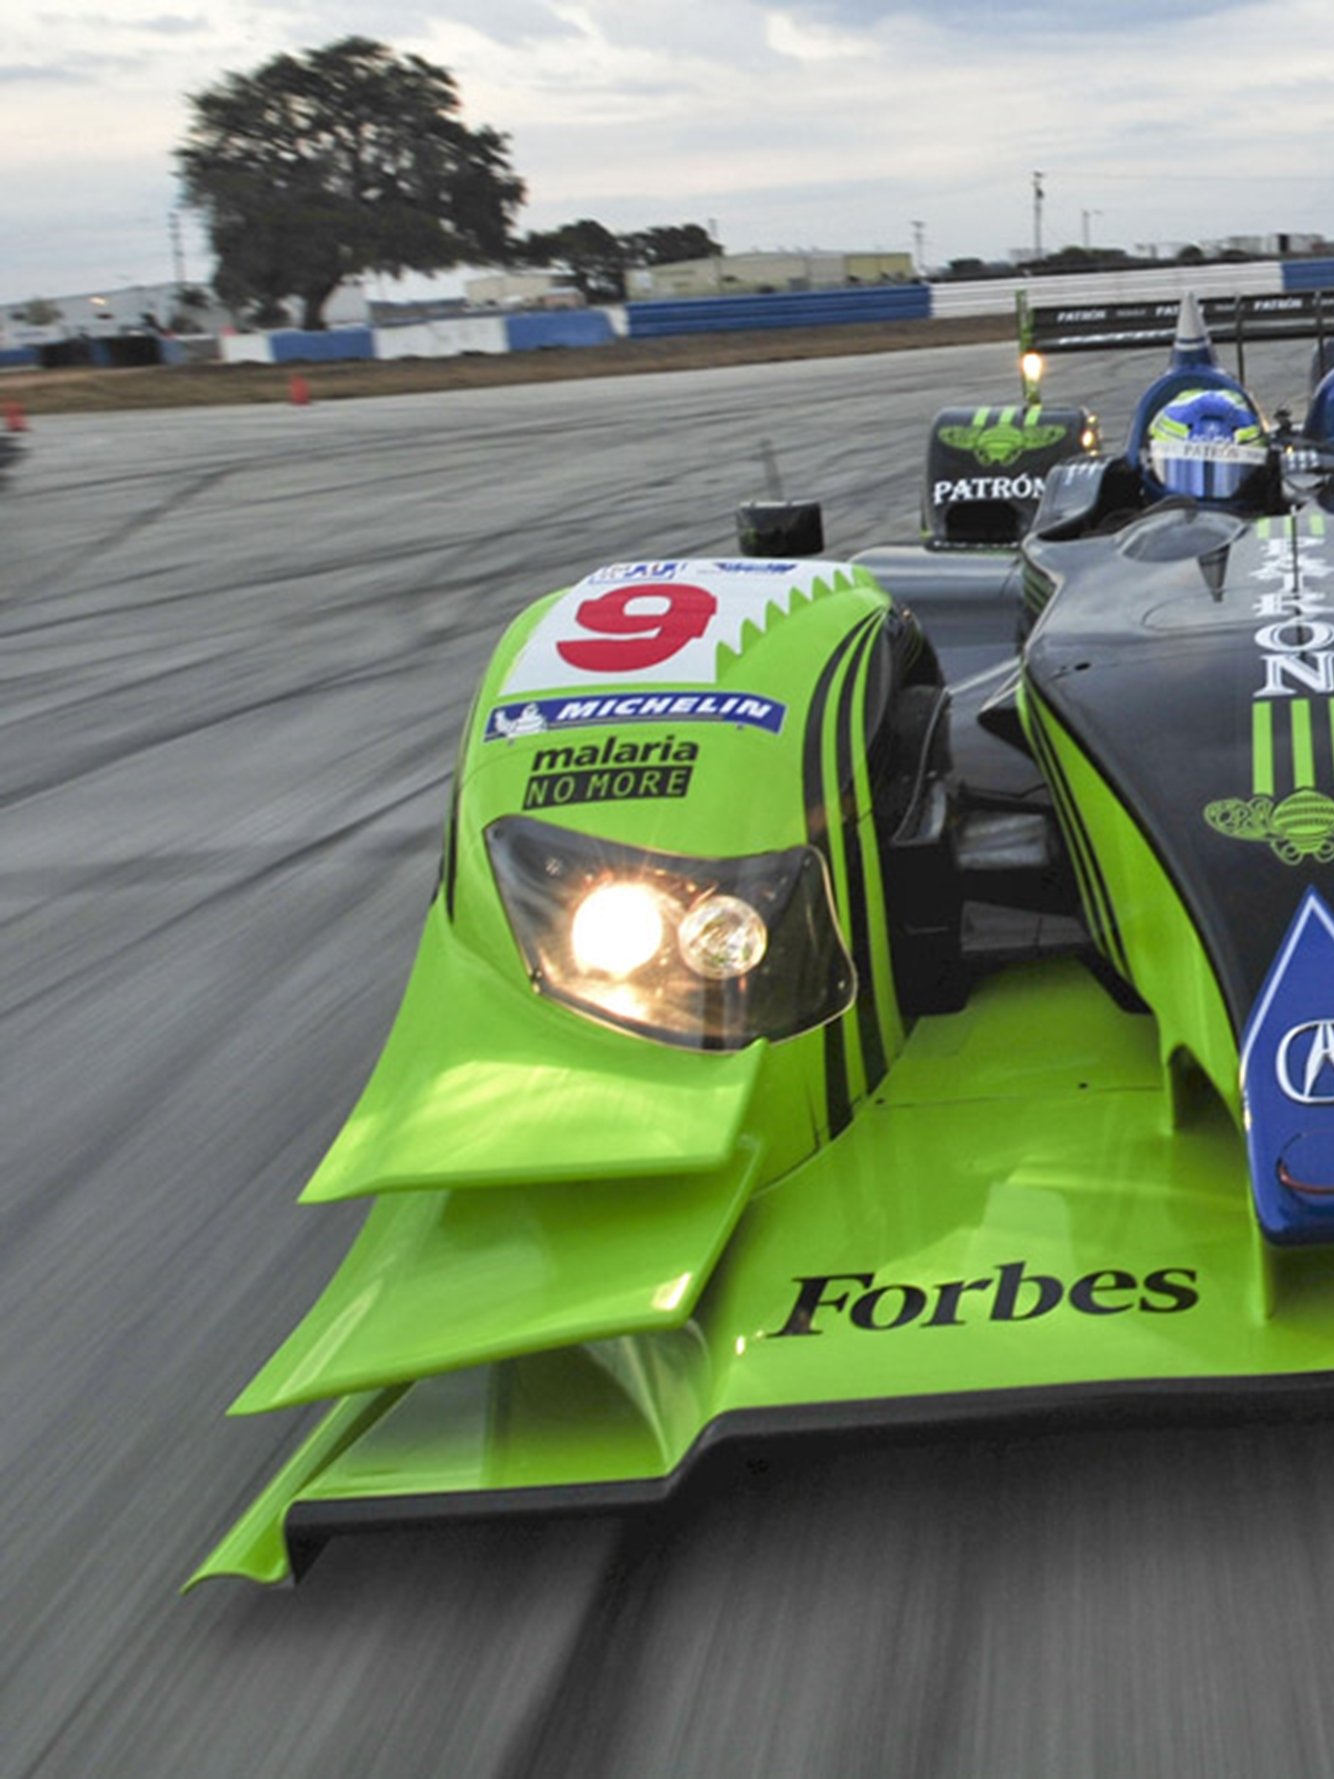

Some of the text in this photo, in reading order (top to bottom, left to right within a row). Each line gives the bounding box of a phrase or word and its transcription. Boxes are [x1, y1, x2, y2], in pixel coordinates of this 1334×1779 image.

[934, 472, 1046, 506] PATRÓN
[556, 583, 718, 673] 9
[555, 695, 773, 722] MICHELIN
[532, 737, 699, 771] malaria
[526, 771, 686, 805] NO MORE
[768, 1260, 1200, 1340] Forbes
